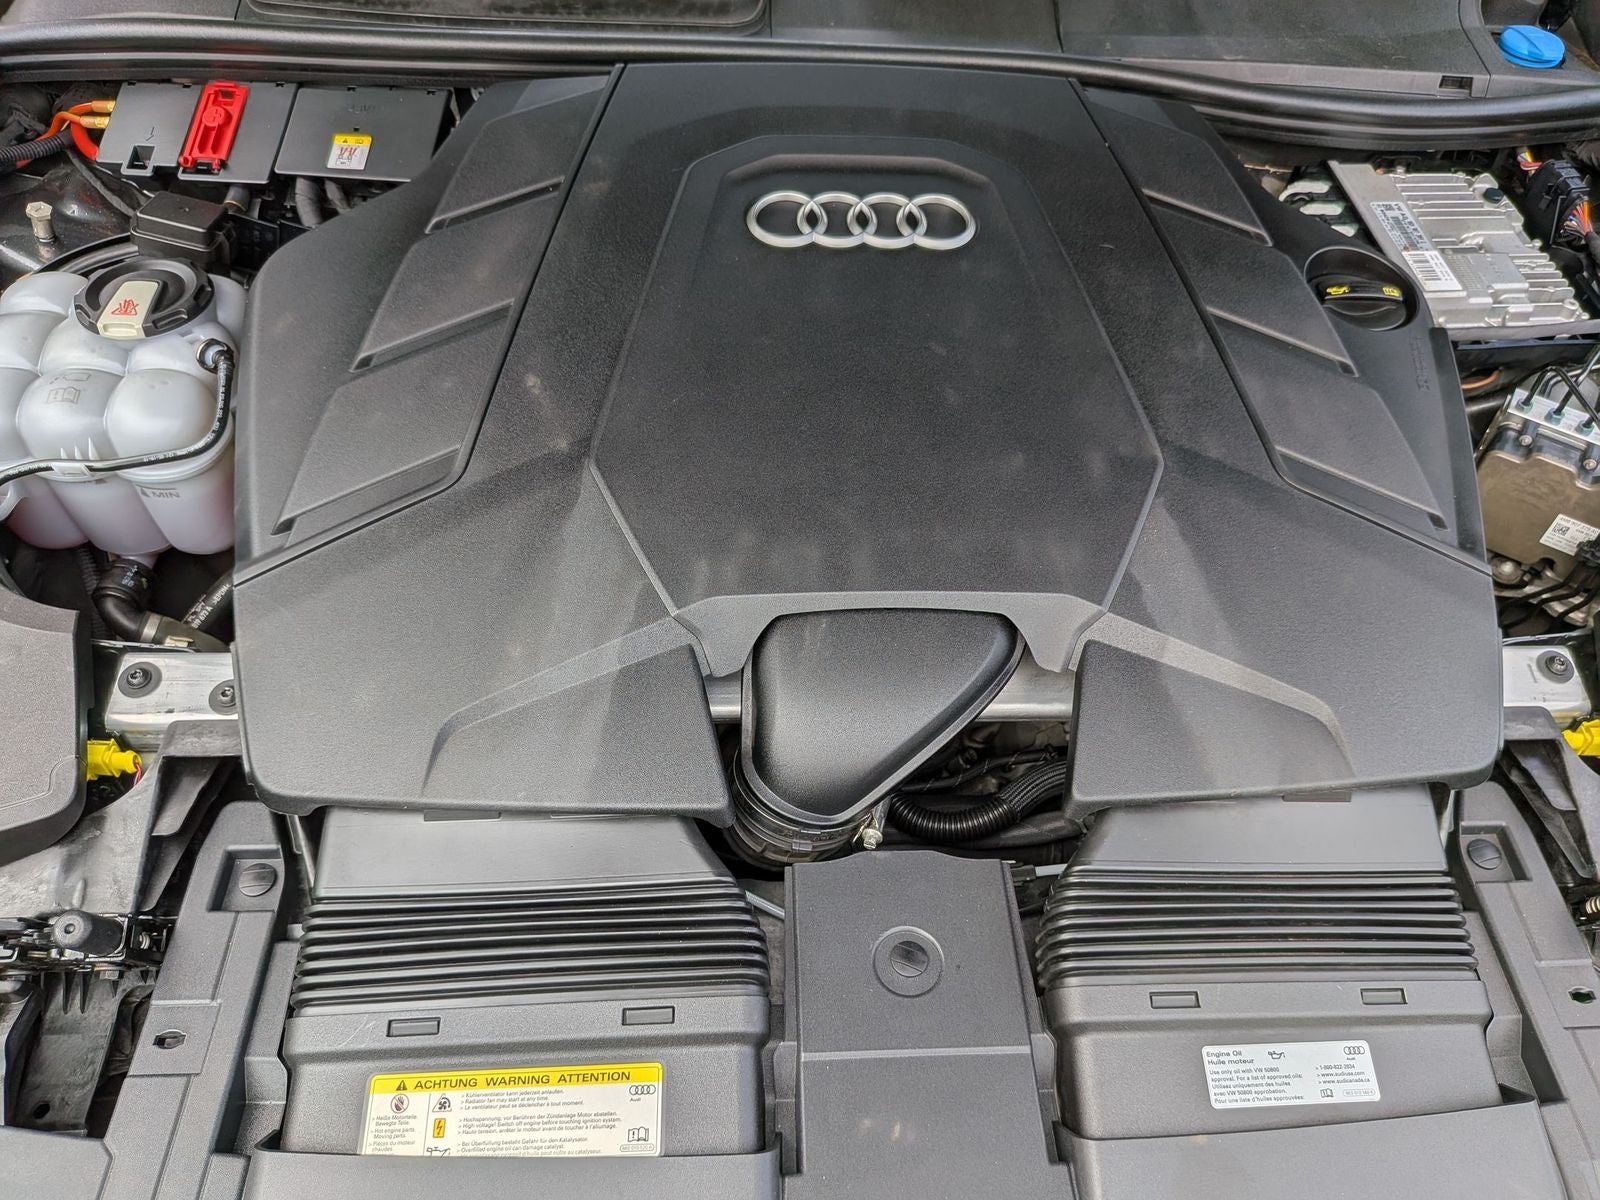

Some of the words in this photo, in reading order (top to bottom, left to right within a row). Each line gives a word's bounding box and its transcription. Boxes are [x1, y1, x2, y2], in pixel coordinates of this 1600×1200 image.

[1206, 1051, 1231, 1059] Engine
[413, 1078, 478, 1090] ACHTUNG
[485, 1075, 550, 1087] WARNING
[557, 1071, 631, 1083] ATTENTION
